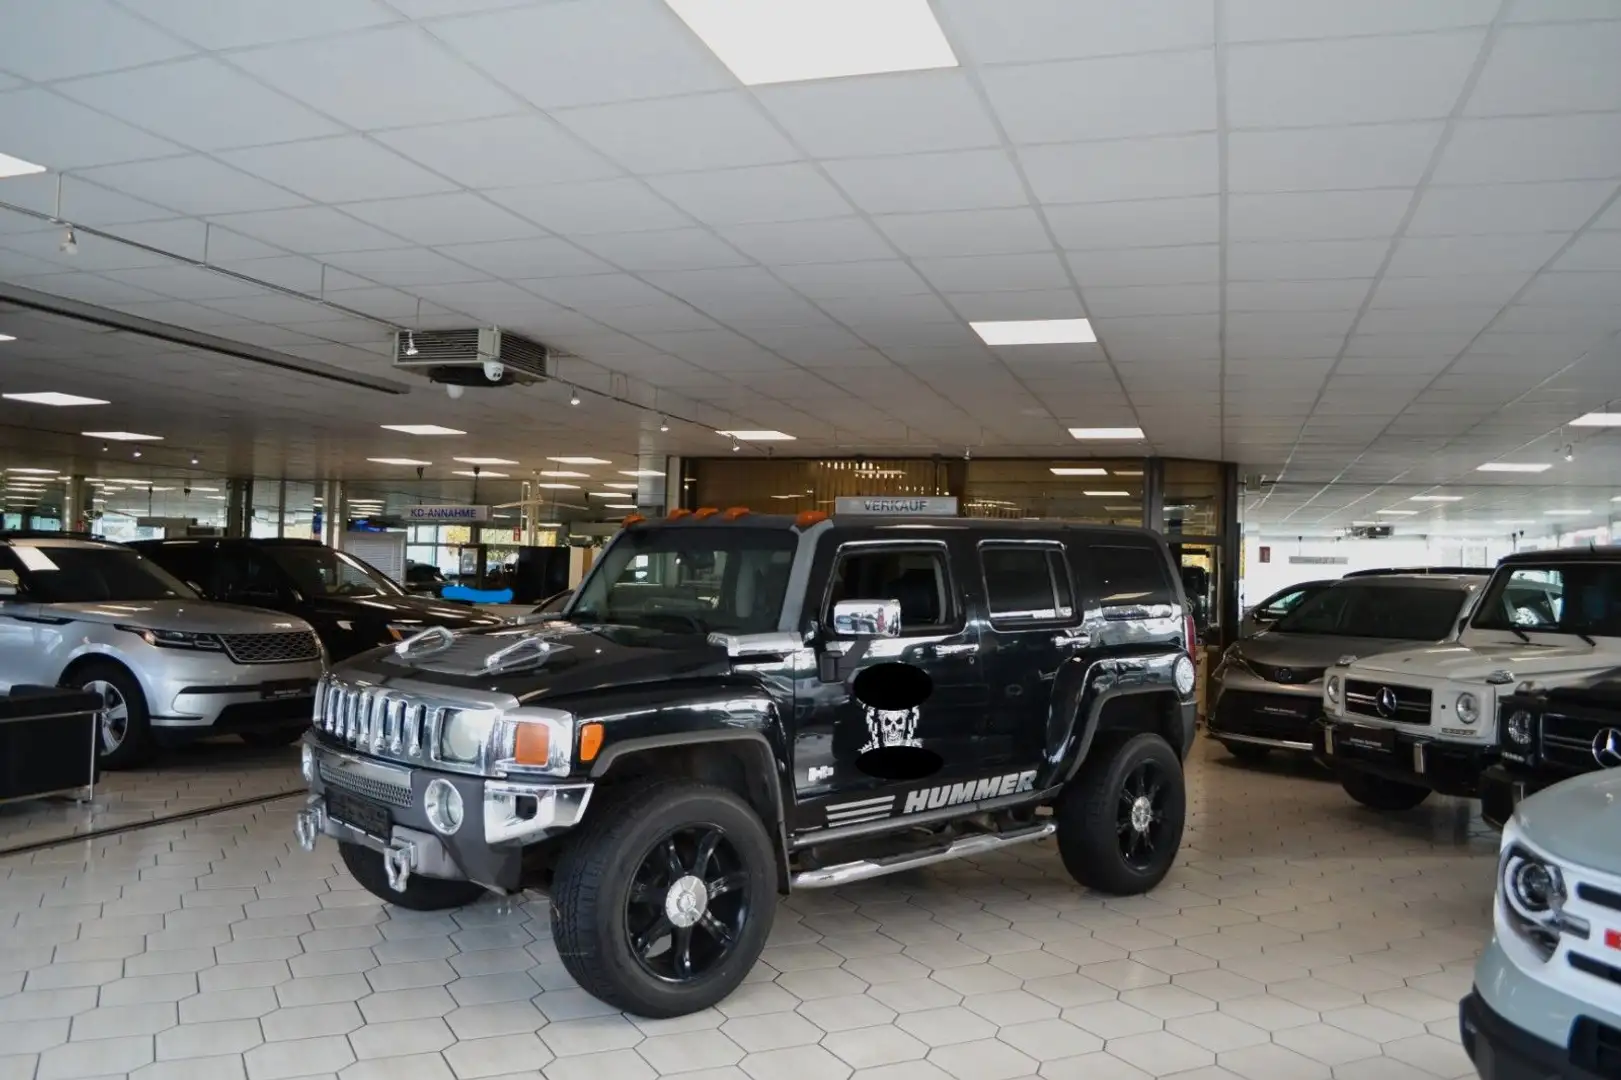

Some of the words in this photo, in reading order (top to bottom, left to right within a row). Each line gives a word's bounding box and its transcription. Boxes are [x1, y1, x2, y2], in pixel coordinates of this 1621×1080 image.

[864, 500, 928, 512] VERKAUF
[410, 508, 476, 518] KD-ANNAHME
[903, 770, 1037, 814] HUMMER
